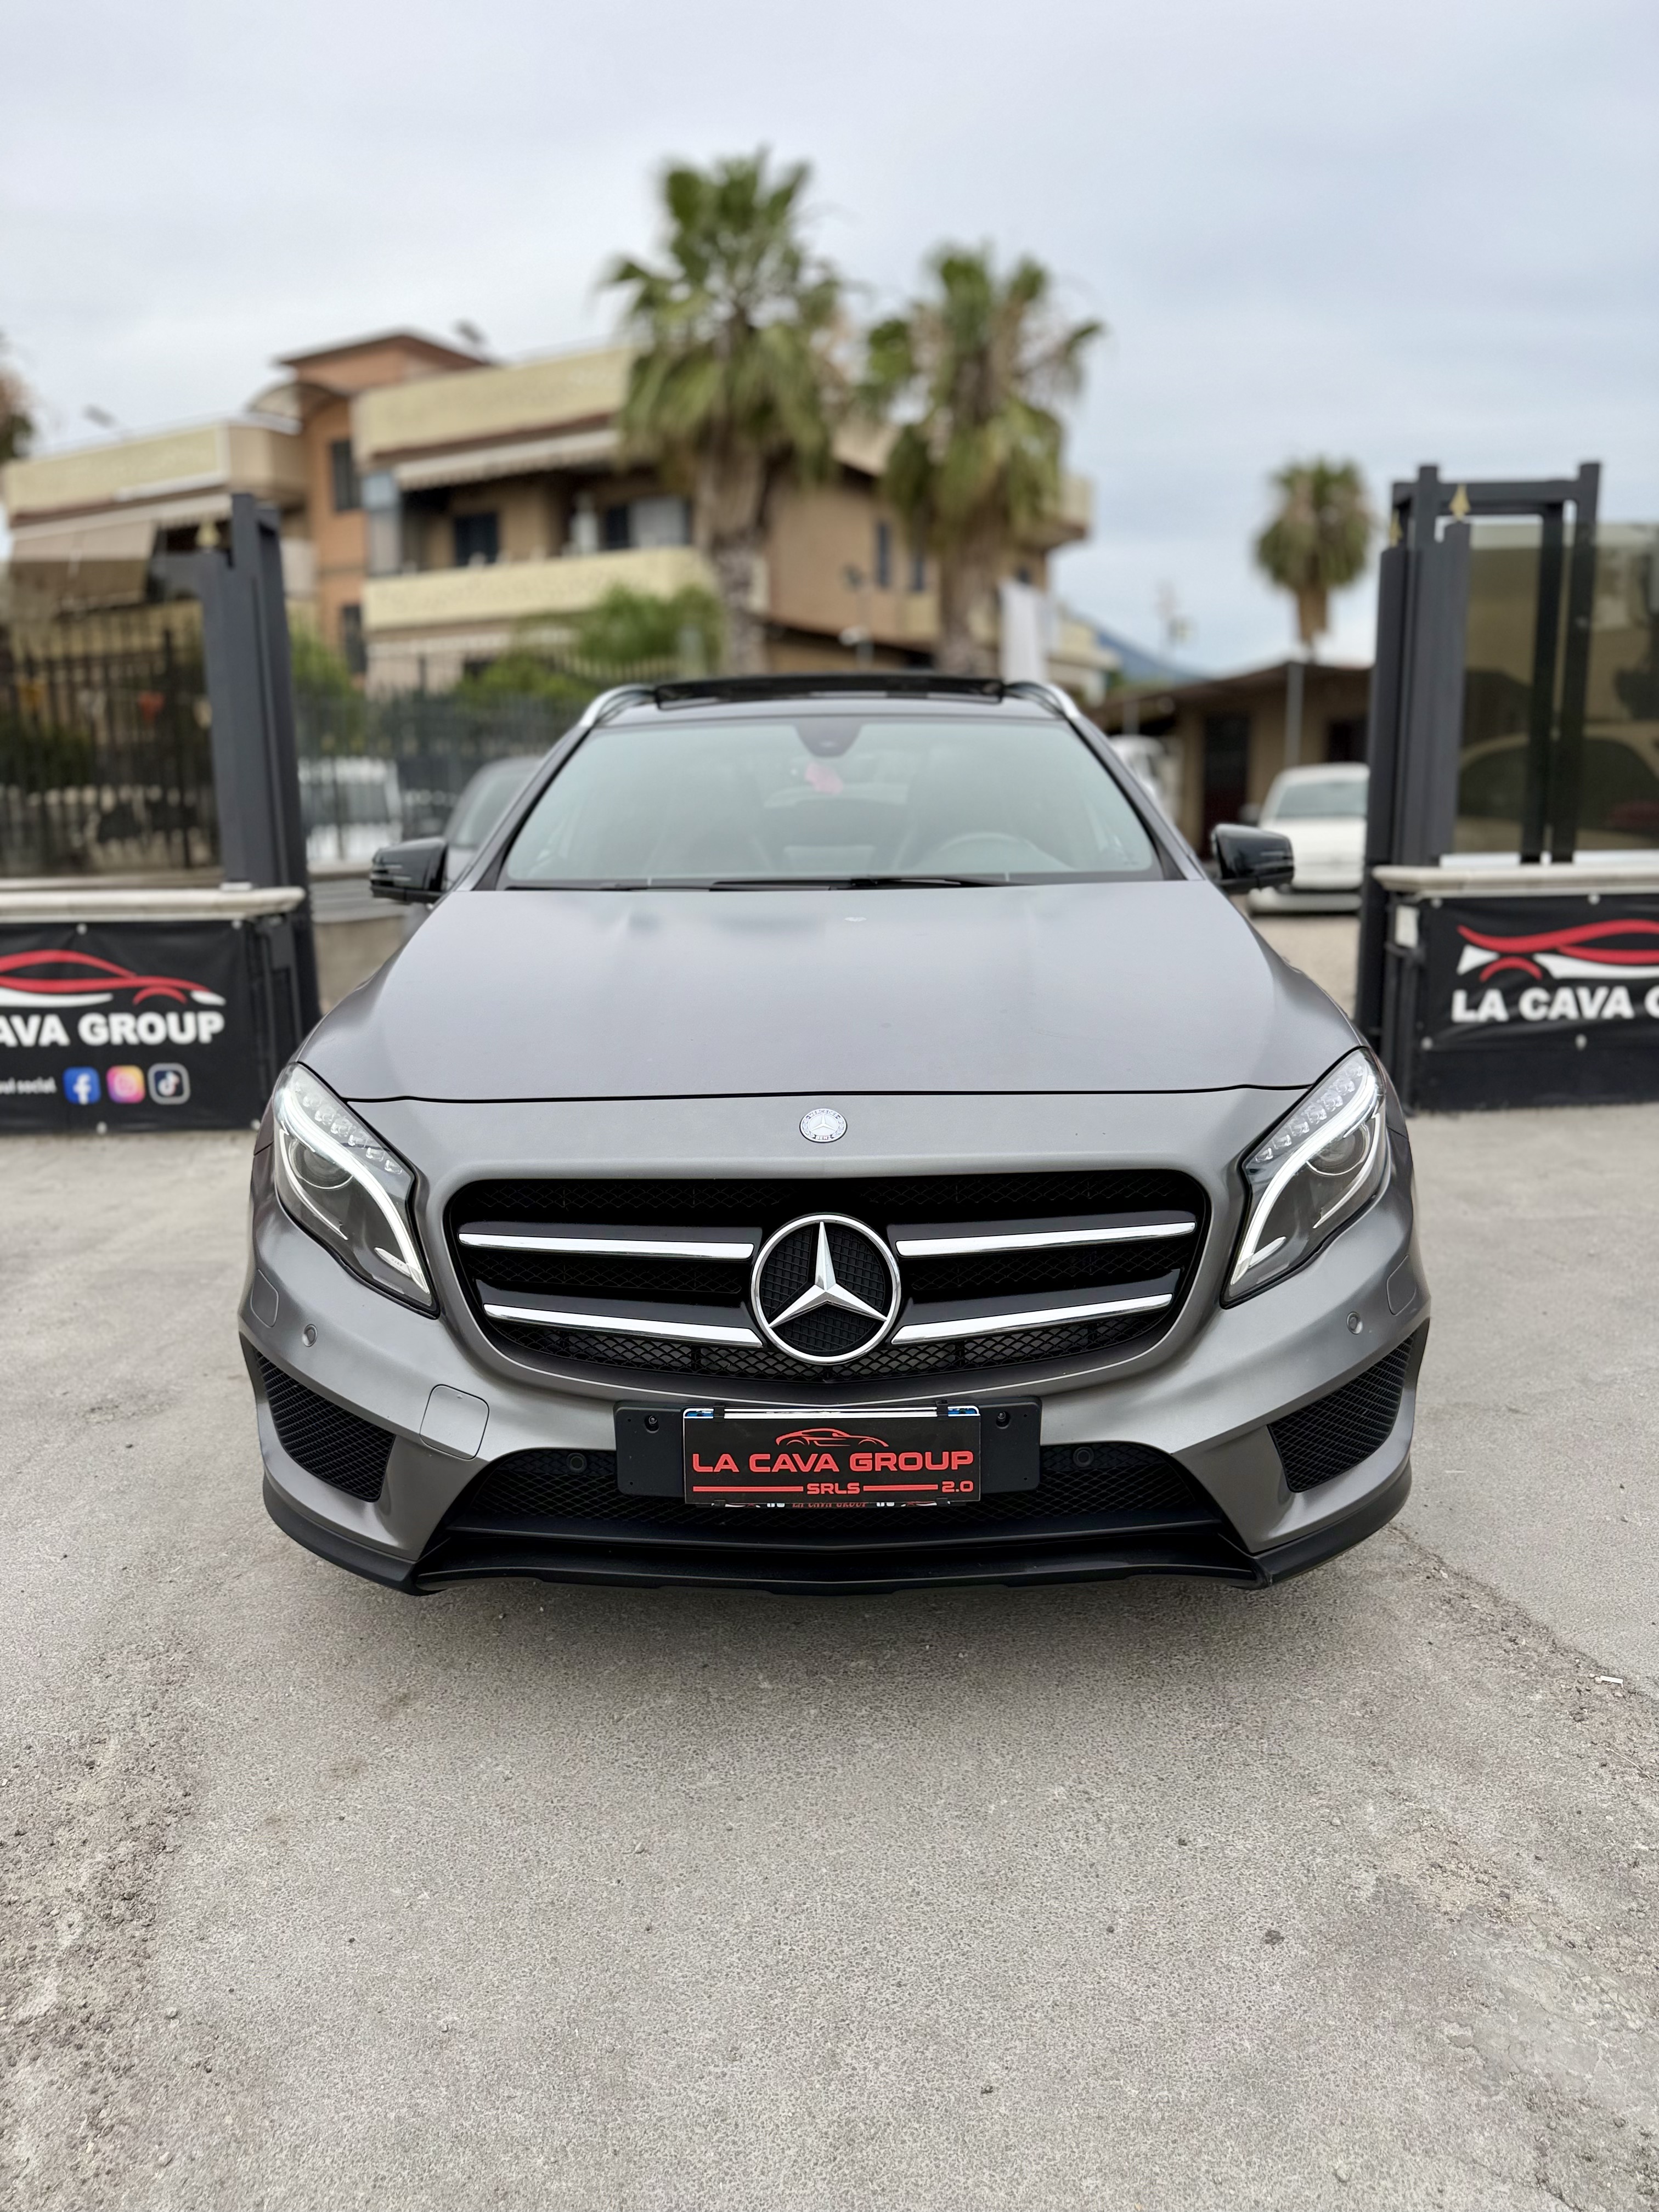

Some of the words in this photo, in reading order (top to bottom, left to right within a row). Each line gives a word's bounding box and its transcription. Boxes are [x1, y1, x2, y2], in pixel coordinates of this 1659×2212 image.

[1452, 989, 1509, 1023] LA
[1519, 986, 1635, 1021] CAVA
[77, 1011, 224, 1046] GROUP
[692, 1453, 740, 1472] LA
[749, 1453, 840, 1472] CAVA
[849, 1451, 974, 1472] GROUP
[806, 1482, 860, 1494] SRLS
[941, 1480, 974, 1493] 2.0
